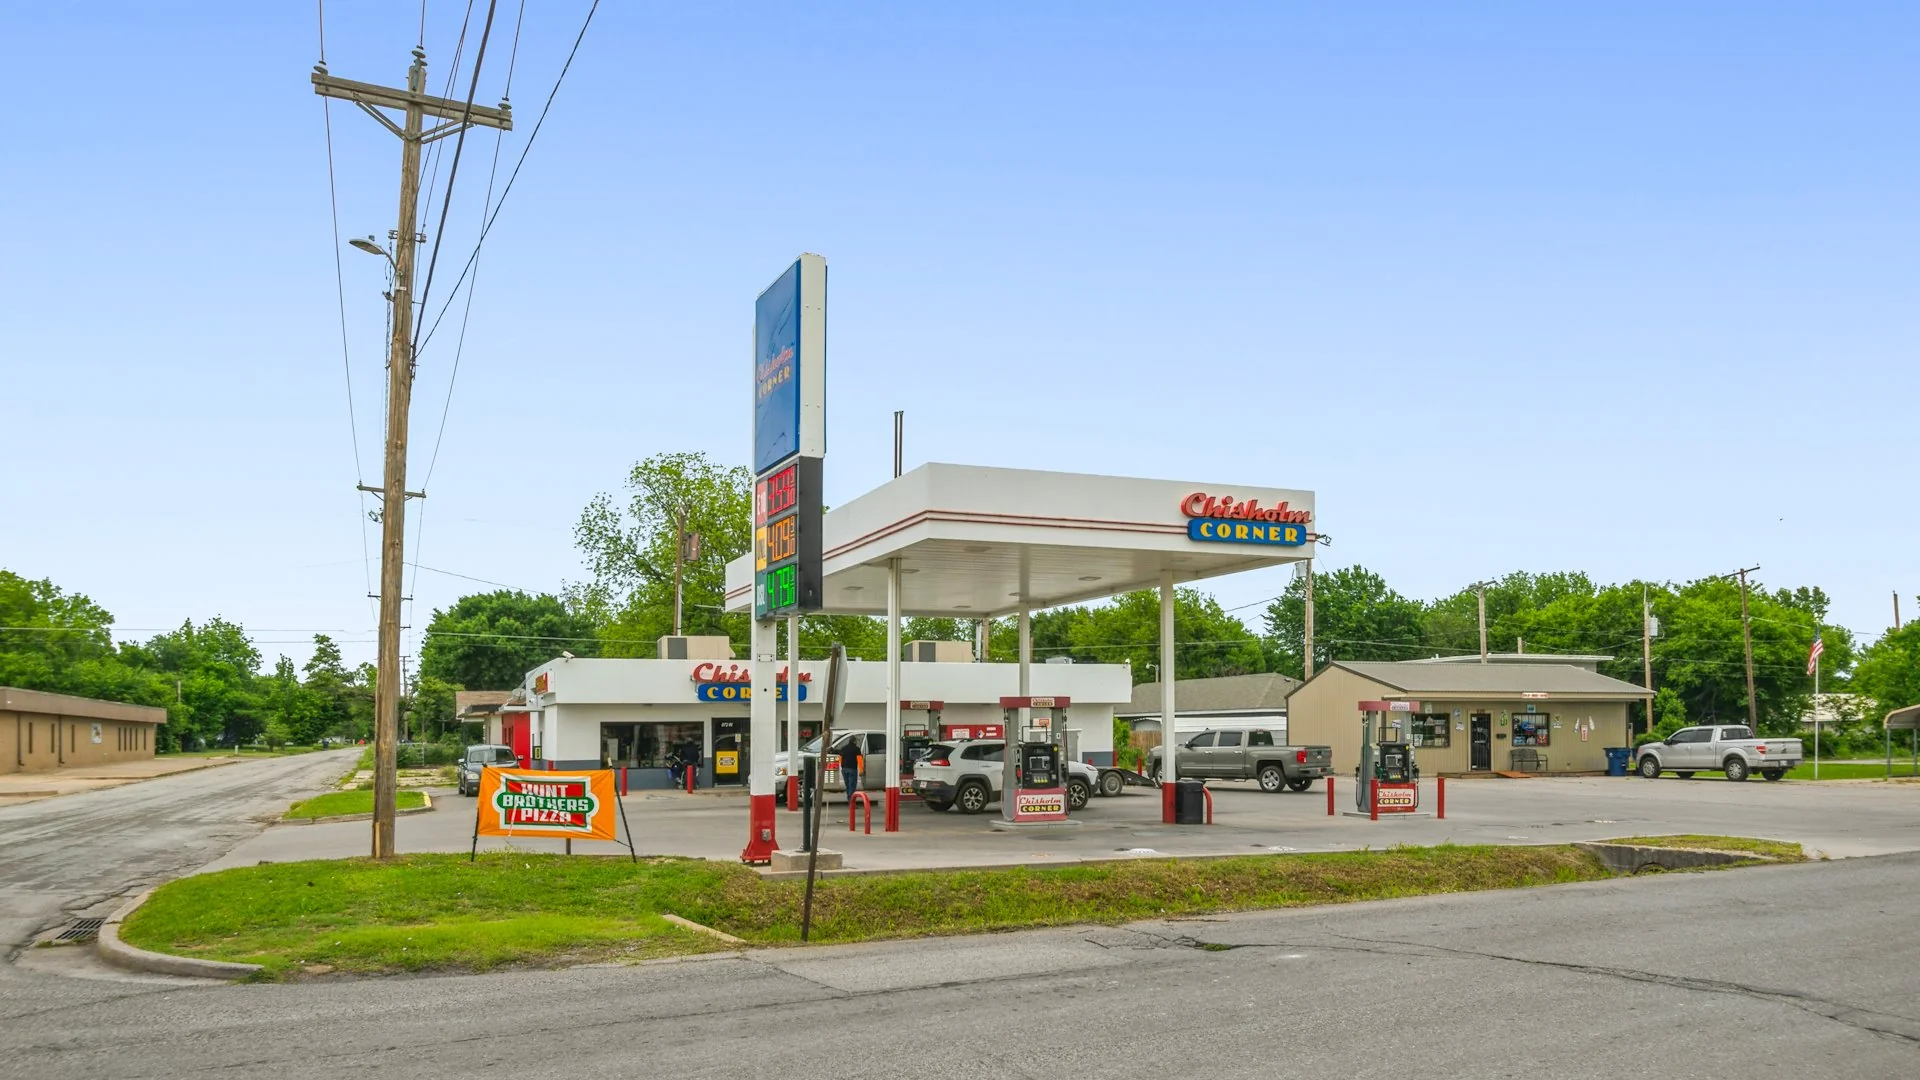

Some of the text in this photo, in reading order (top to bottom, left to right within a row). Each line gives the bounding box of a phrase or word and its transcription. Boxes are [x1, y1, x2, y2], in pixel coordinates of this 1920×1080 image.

[758, 365, 791, 398] CORNER
[1180, 492, 1312, 524] Chisholm
[1200, 522, 1298, 543] CORNER
[520, 783, 569, 798] HUNT
[502, 795, 588, 811] BROTHERS
[1020, 796, 1062, 804] Chisholm
[520, 808, 572, 823] PIZZA
